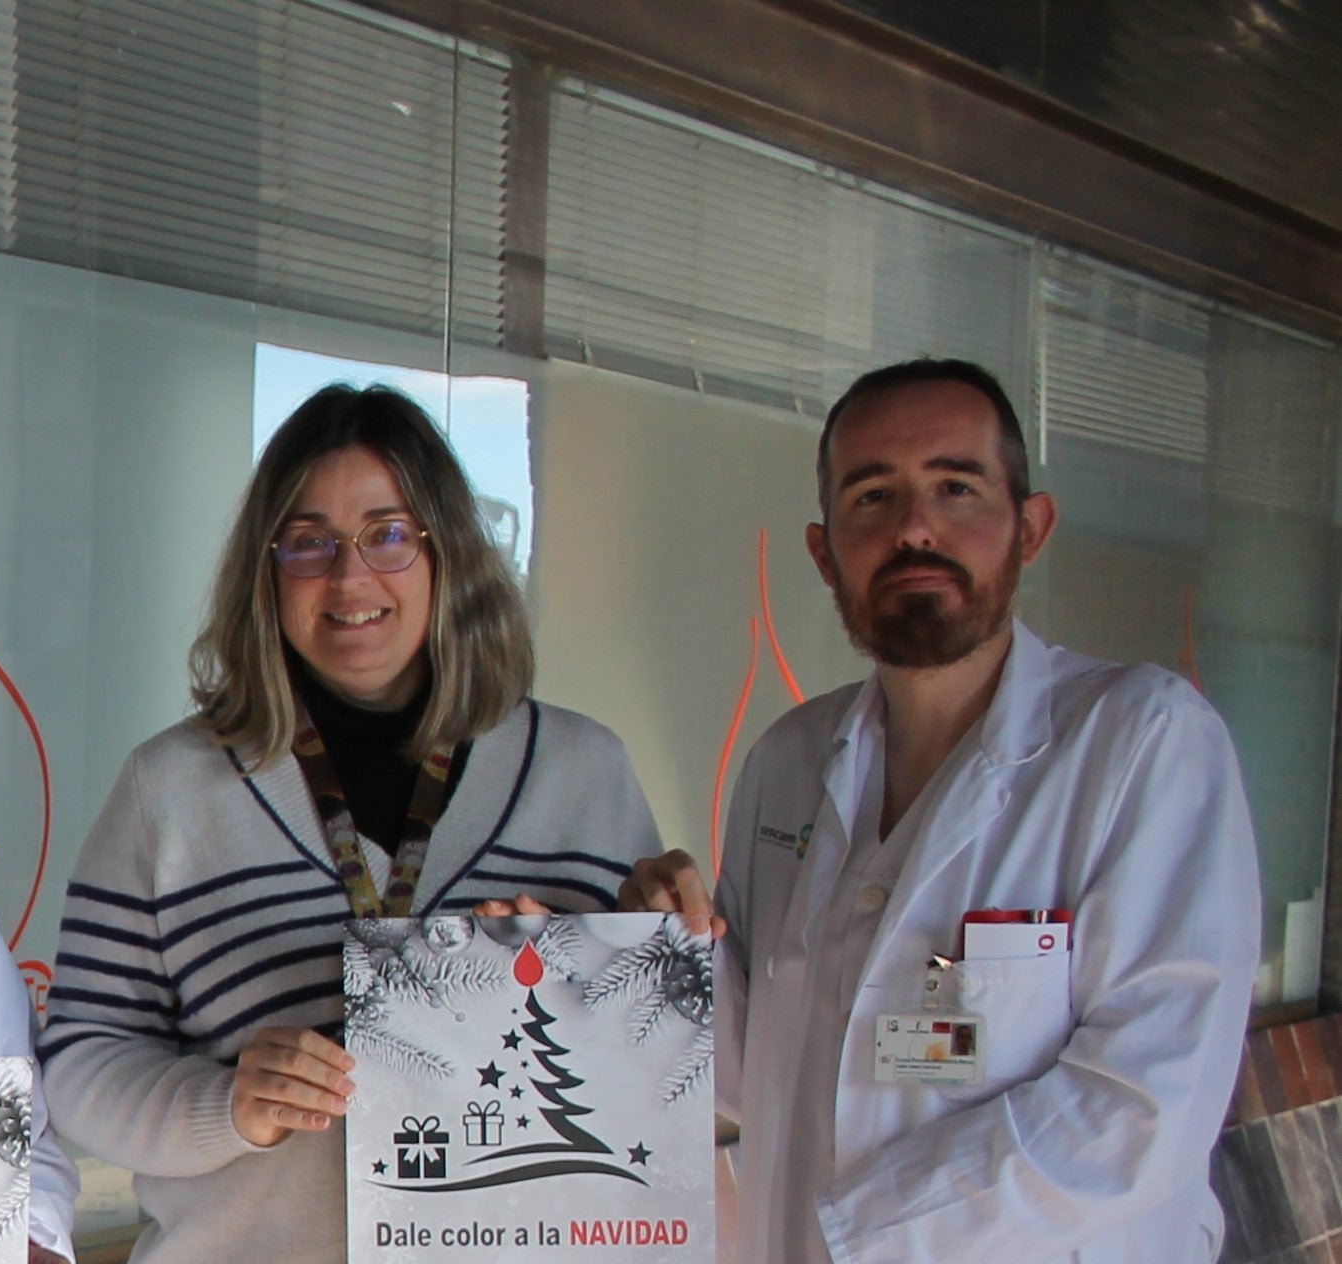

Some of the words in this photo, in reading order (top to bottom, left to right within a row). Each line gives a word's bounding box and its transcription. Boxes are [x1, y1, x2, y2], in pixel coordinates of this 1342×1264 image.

[376, 1222, 431, 1247] Dale
[441, 1222, 505, 1246] color
[515, 1228, 528, 1245] a
[540, 1221, 560, 1245] la
[570, 1220, 688, 1245] NAVIDAD
